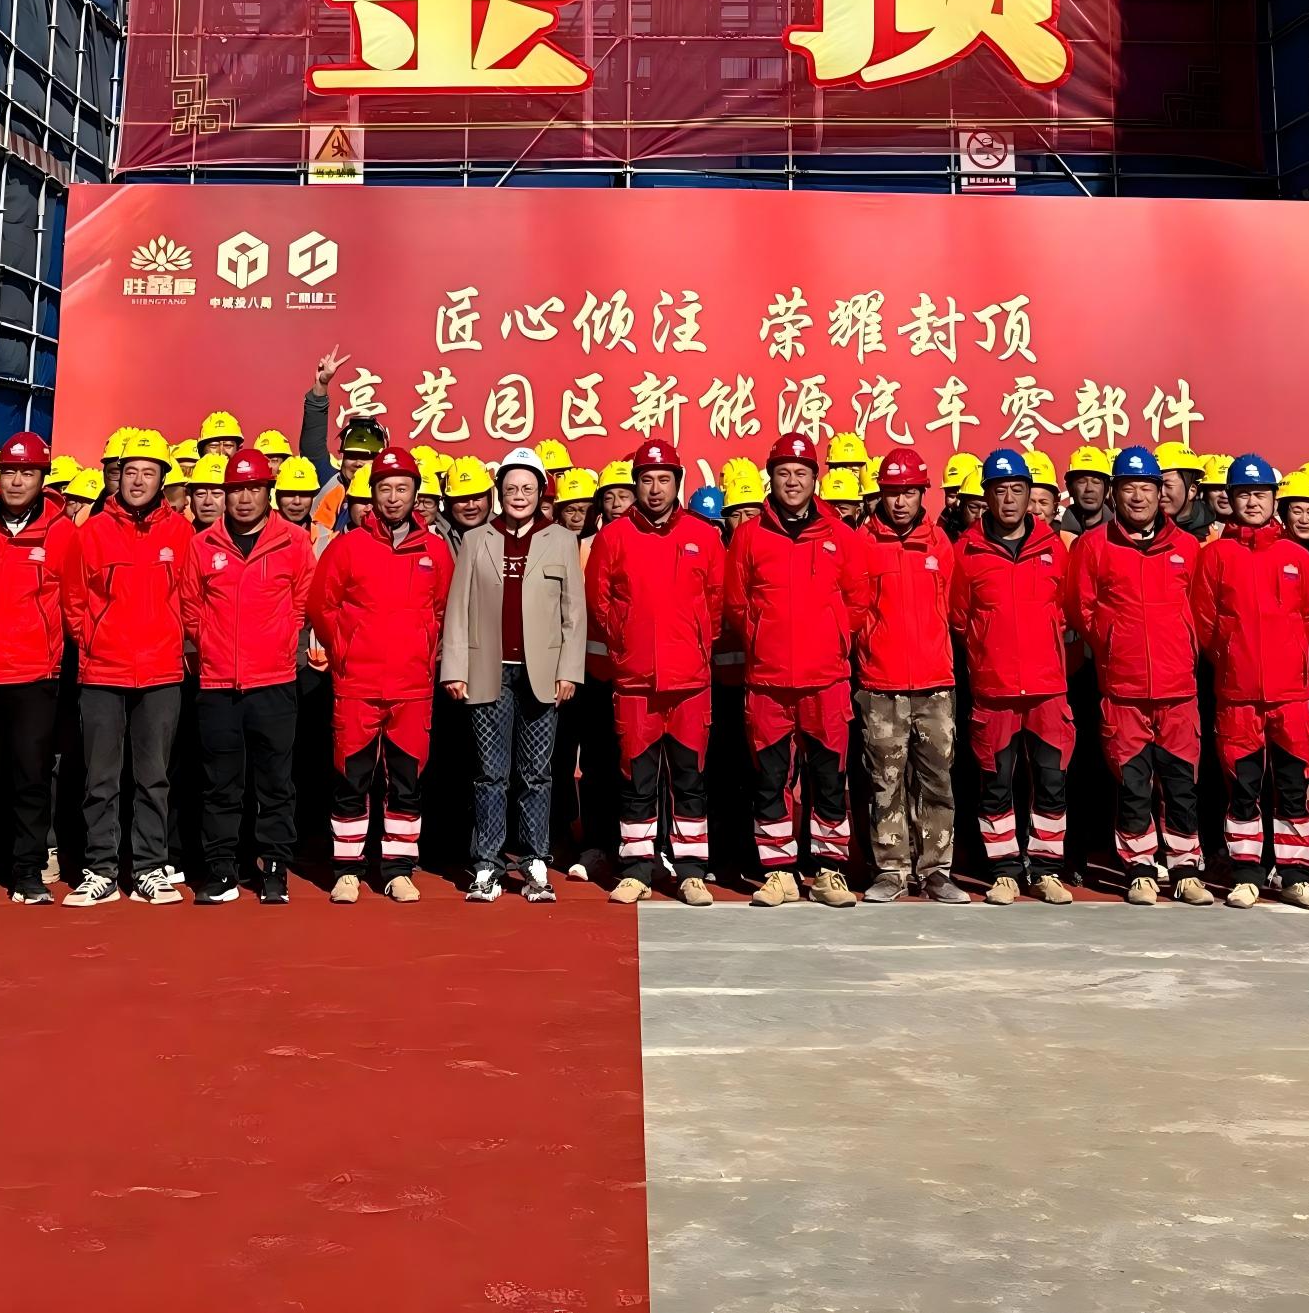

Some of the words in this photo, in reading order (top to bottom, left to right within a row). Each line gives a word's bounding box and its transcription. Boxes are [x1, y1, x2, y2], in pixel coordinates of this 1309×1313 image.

[435, 286, 708, 354] 匠心倾注
[758, 286, 1038, 364] 荣耀封顶
